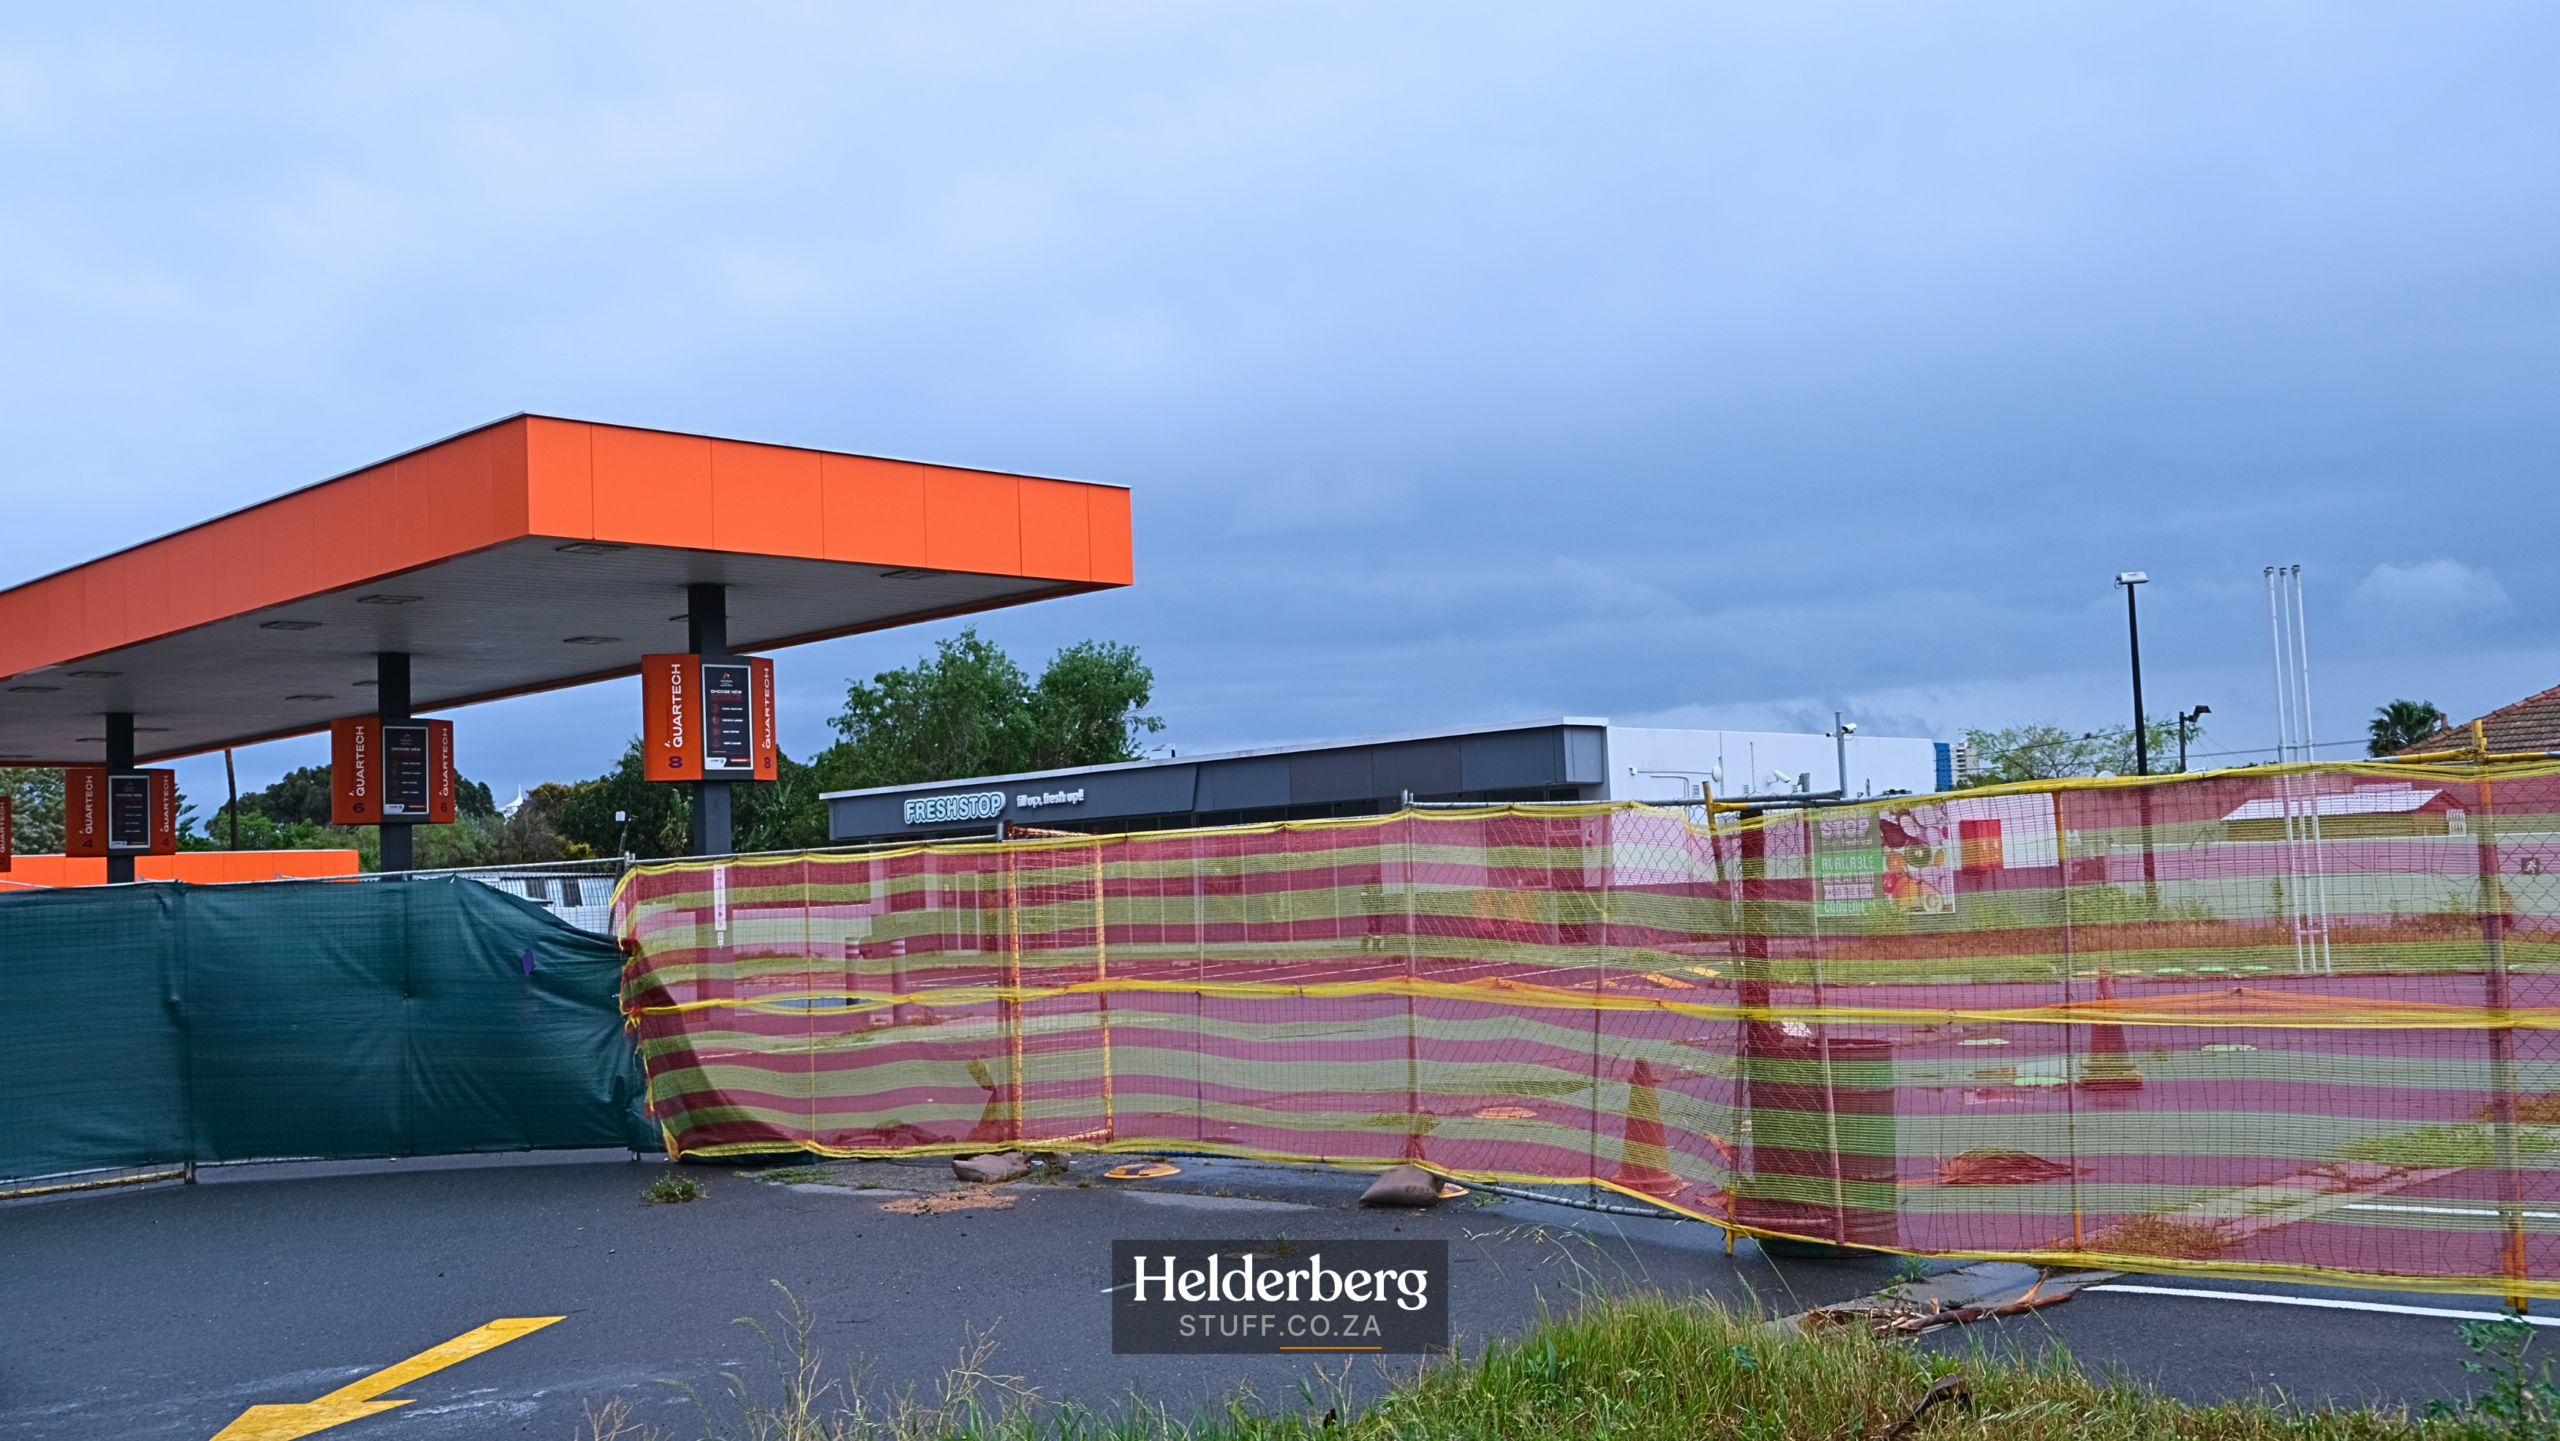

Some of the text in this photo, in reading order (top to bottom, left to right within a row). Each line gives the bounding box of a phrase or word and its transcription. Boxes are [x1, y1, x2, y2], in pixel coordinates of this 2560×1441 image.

[671, 664, 683, 748] QUARTECH
[355, 726, 365, 796] QUARTECH
[668, 755, 683, 769] 8
[764, 756, 771, 769] 8
[85, 776, 93, 834] QUARTECH
[352, 803, 365, 814] 6
[440, 802, 448, 813] 6
[904, 792, 1005, 823] FRESHSTOP
[1821, 818, 1870, 838] STOP
[82, 839, 94, 849] 4
[162, 838, 170, 847] 4
[1821, 855, 1874, 870] AVAILABLE
